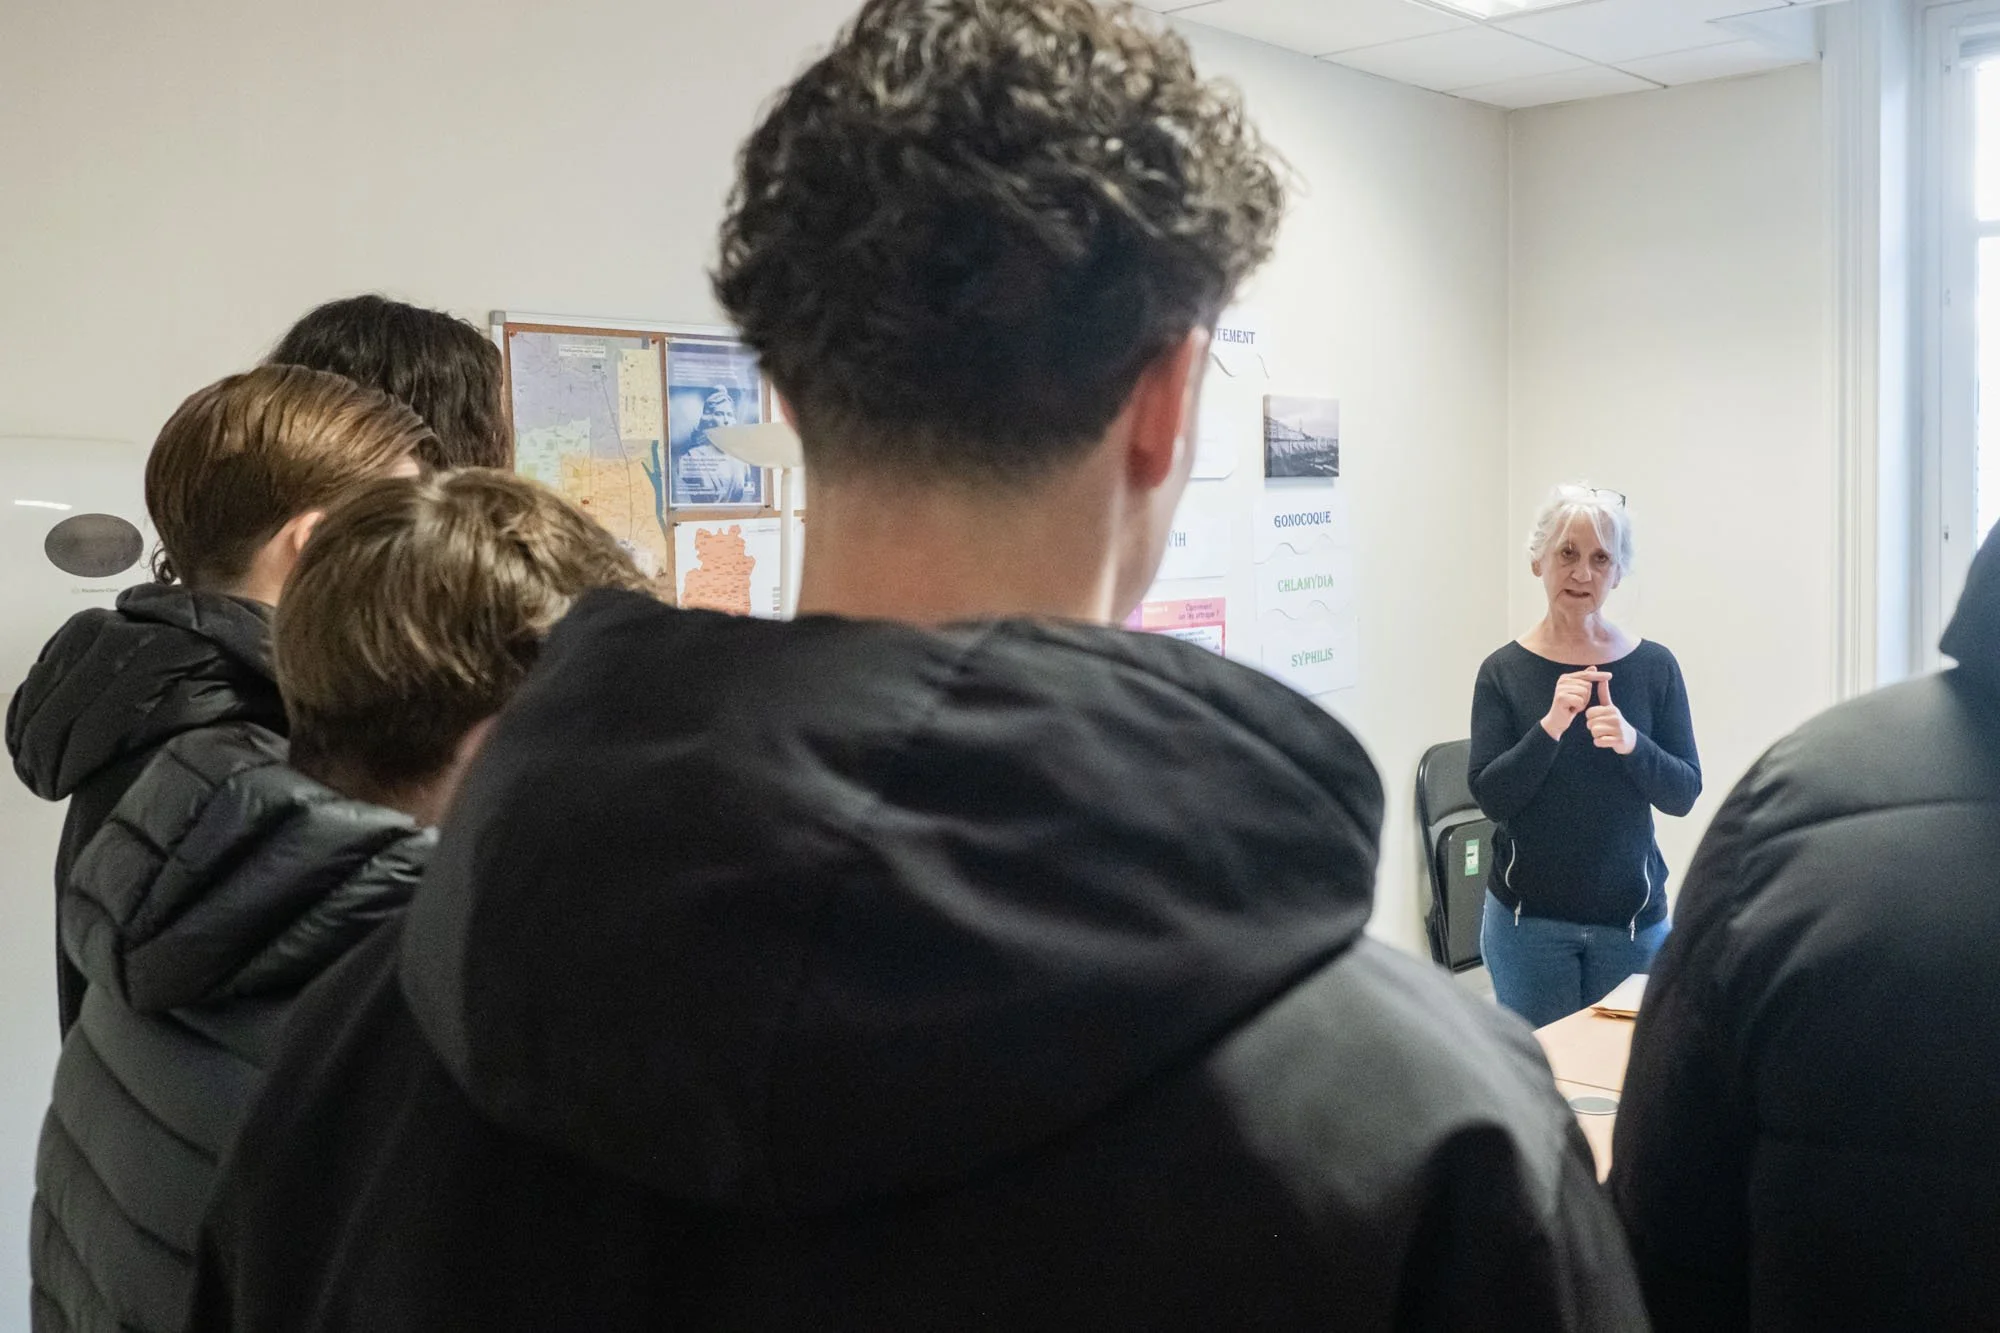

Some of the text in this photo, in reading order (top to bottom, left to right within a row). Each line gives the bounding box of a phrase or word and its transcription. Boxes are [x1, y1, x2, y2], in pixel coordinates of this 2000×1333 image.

[1216, 327, 1256, 345] TEMENT
[1274, 511, 1332, 528] GONOCOQUE
[1277, 574, 1334, 592] CHLAMYDIA
[1291, 647, 1334, 667] SYPHILIS
